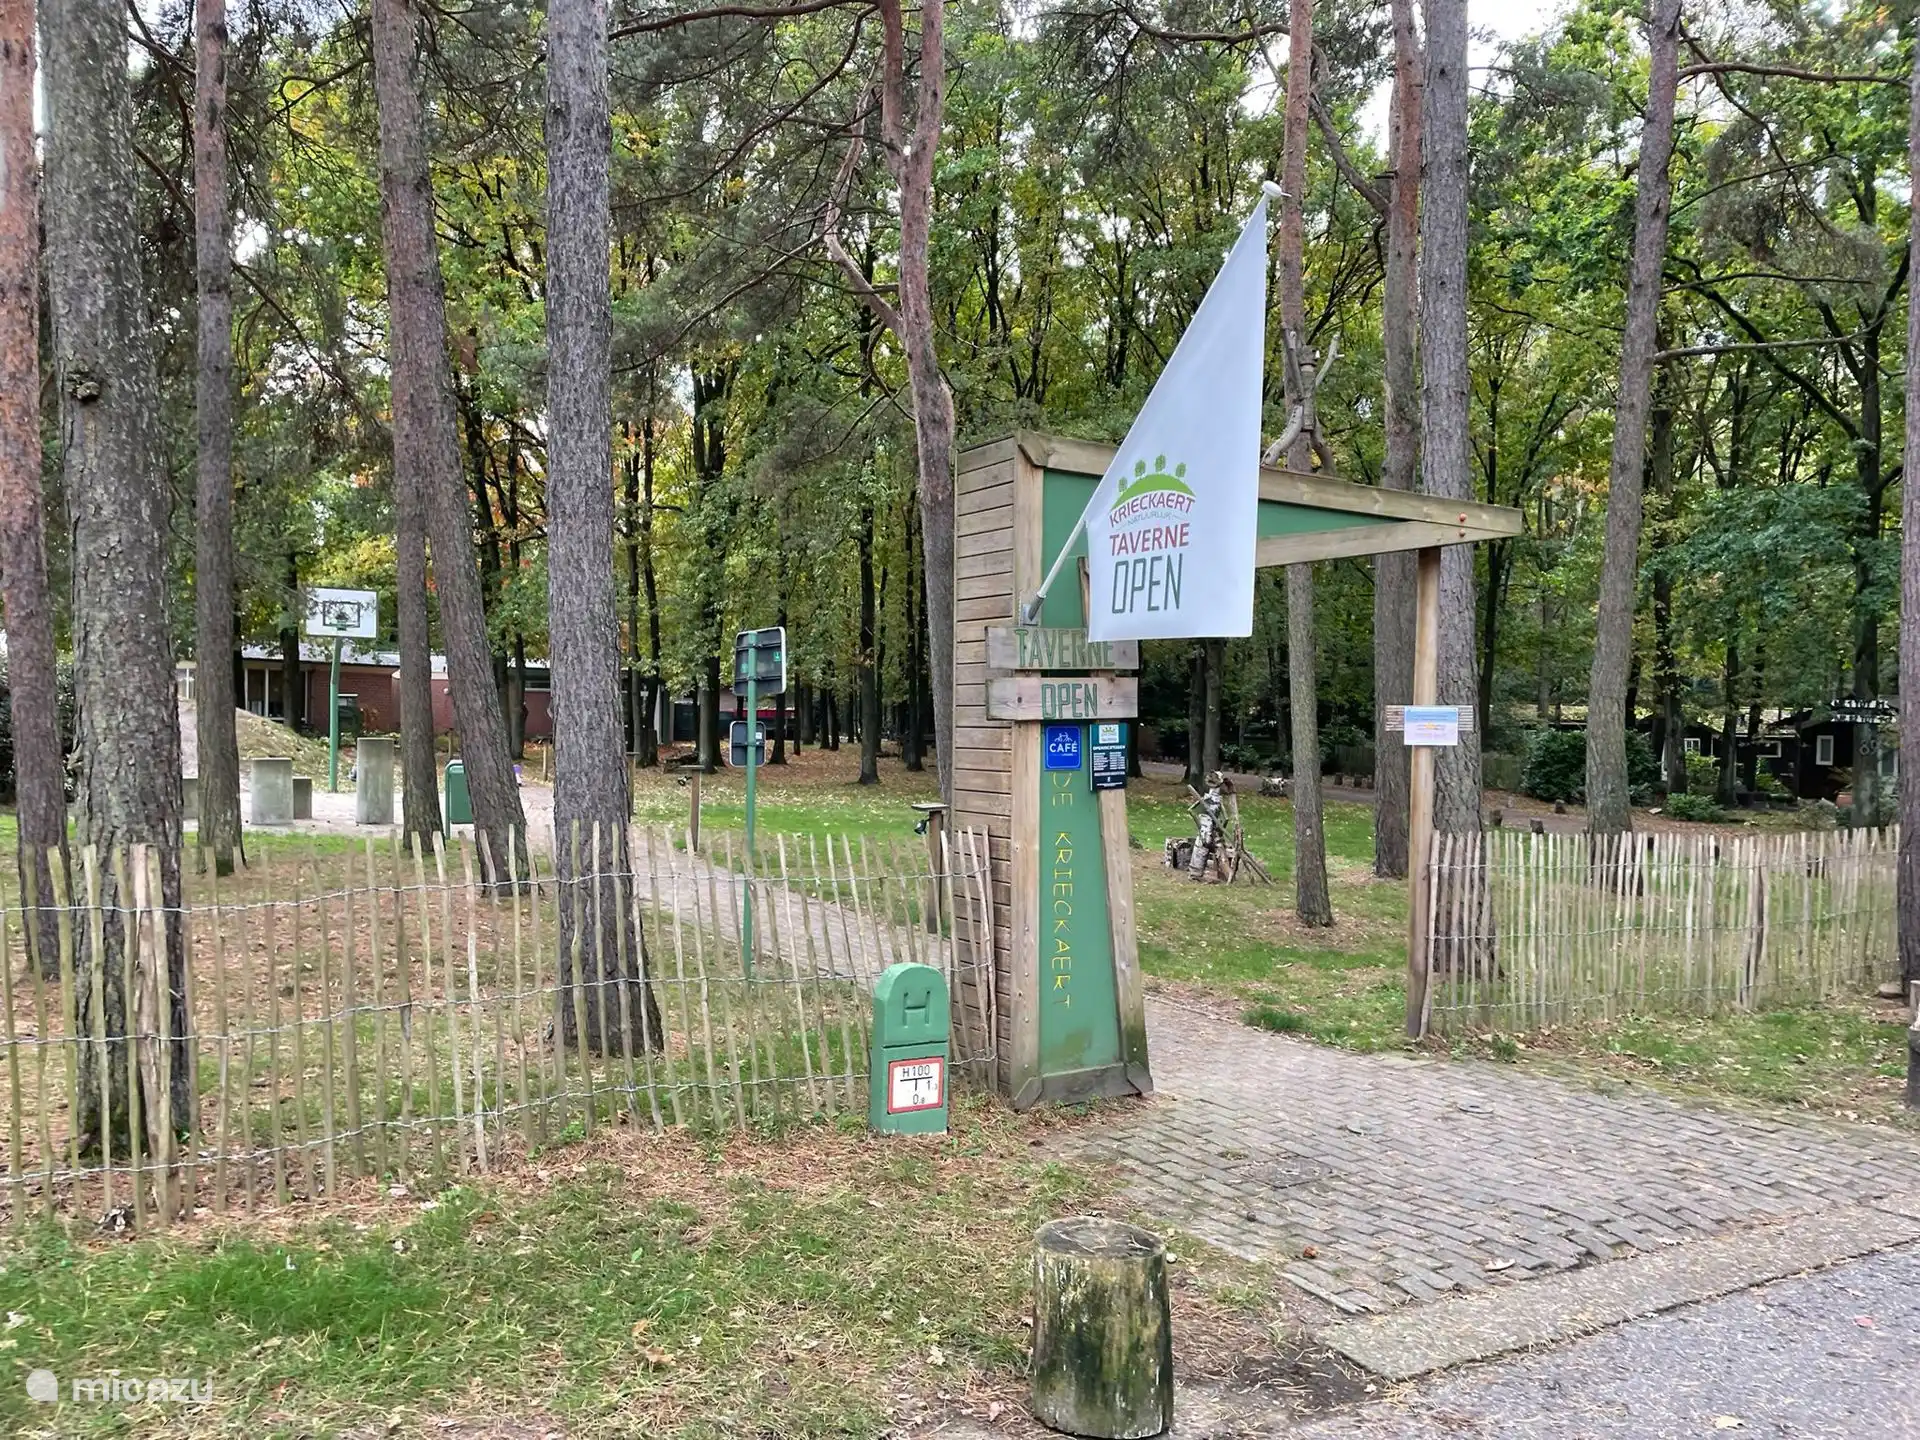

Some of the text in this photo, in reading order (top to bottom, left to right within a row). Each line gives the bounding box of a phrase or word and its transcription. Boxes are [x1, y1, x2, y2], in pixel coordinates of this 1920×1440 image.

[1109, 492, 1195, 527] KRIECKAERT
[1110, 523, 1190, 556] TAVERNE
[1112, 553, 1183, 614] OPEN
[1015, 629, 1115, 668] TAVERNE
[1041, 682, 1098, 719] OPEN
[1049, 741, 1078, 753] CAFÉ
[1052, 832, 1073, 1008] KRIECKAERT
[902, 990, 931, 1028] H
[902, 1064, 931, 1078] H100
